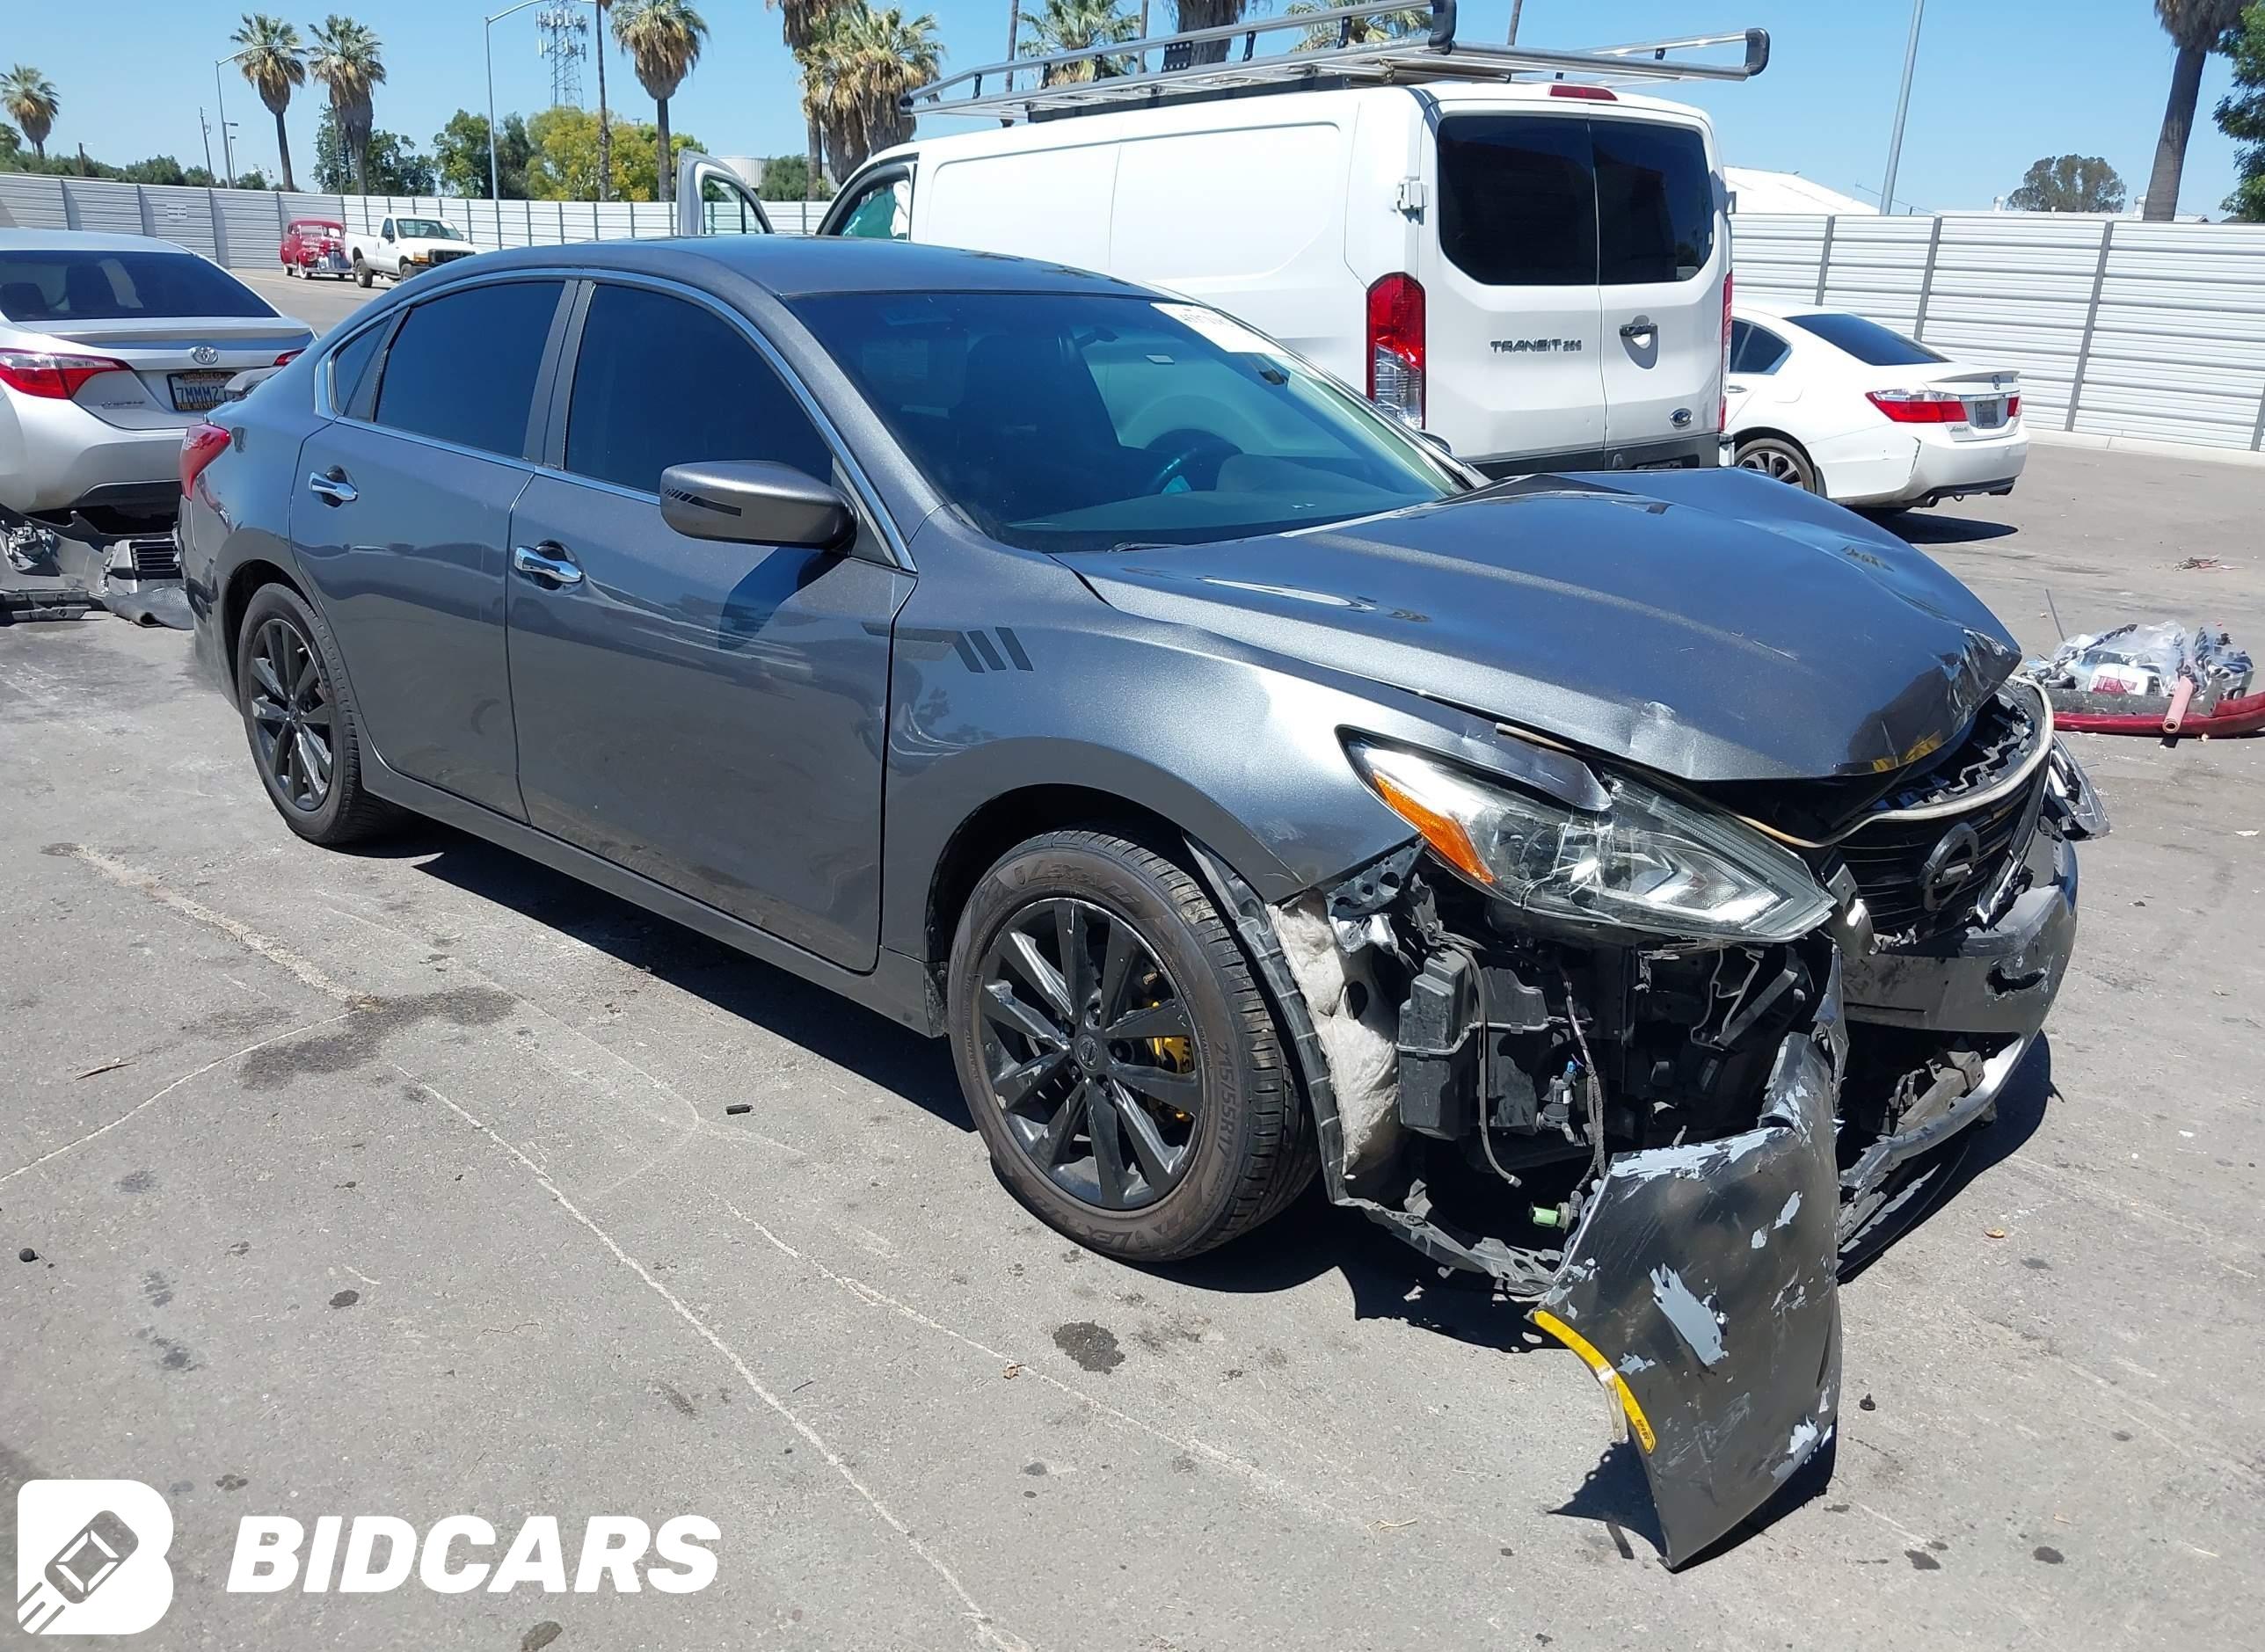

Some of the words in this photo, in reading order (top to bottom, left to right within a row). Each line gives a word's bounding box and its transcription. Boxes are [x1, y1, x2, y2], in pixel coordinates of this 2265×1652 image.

[1490, 338, 1561, 353] TRANSIT
[176, 386, 228, 404] 7MMM27
[1214, 1041, 1241, 1154] 215/55R17
